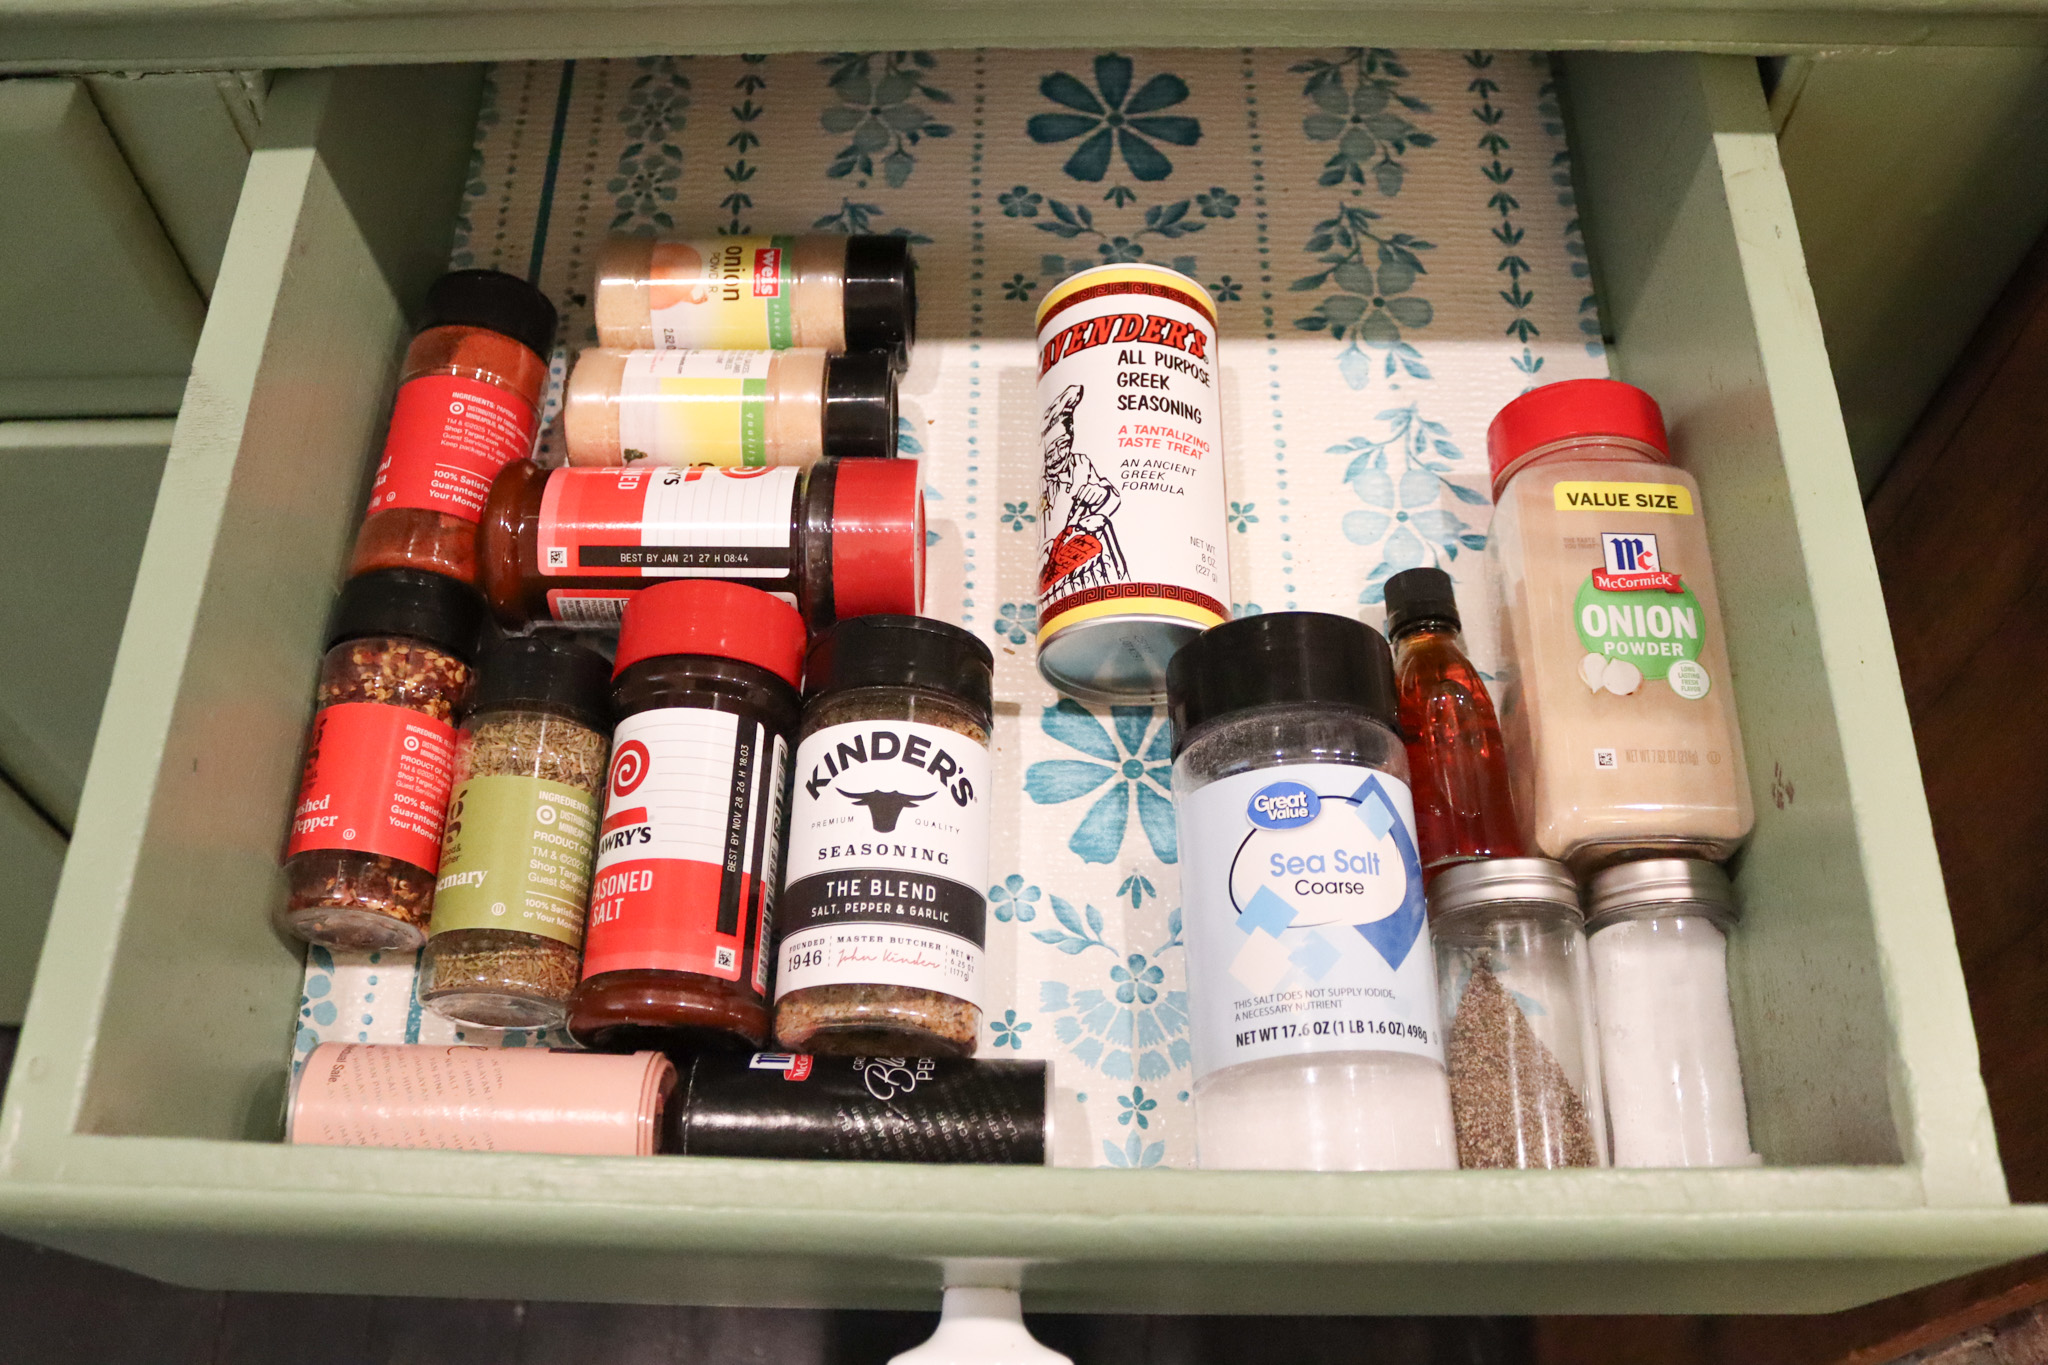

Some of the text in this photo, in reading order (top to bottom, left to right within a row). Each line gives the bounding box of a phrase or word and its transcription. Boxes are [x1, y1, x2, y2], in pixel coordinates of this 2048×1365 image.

[708, 252, 720, 294] POWDR
[722, 246, 745, 302] onion
[760, 250, 777, 295] weis
[1037, 314, 1207, 379] AVENDER'S
[1117, 349, 1210, 387] ALL PURPOSE
[1117, 372, 1171, 391] GREEK
[1117, 395, 1202, 424] SEASONING
[444, 425, 462, 434] Shop
[1118, 425, 1210, 453] A TANTALIZING
[1117, 438, 1203, 460] TASTE TREAT
[1120, 459, 1198, 477] AN ANCIENT
[1120, 470, 1166, 481] GREEK
[431, 480, 484, 501] Guaranteed
[434, 470, 490, 493] 100% Satisfa
[1122, 482, 1185, 496] FORMULA
[429, 489, 481, 512] Your Money
[1566, 492, 1679, 509] VALUE SIZE
[1190, 536, 1203, 549] NET
[619, 553, 749, 563] BEST BY JAN 21 27 H 08:44
[1202, 553, 1206, 562] 8
[1596, 575, 1672, 589] McCormick
[1581, 604, 1698, 639] ONION
[1604, 641, 1685, 657] POWDER
[401, 754, 434, 770] PRODUCT
[740, 744, 749, 768] 18:03
[397, 771, 414, 782] Shop
[805, 731, 974, 808] KINDER'S
[737, 781, 745, 794] 26
[296, 793, 331, 817] shed
[394, 793, 445, 821] 100% Satisfac
[735, 795, 744, 809] 28
[1254, 791, 1308, 812] Great
[391, 804, 438, 830] Guaranteed
[732, 811, 743, 831] NOV
[1267, 806, 1308, 821] Value
[389, 816, 436, 843] Your Money
[811, 815, 961, 834] PREMIUM QUALITY
[533, 830, 579, 851] PRODUCT
[599, 827, 651, 855] AWRY'S
[731, 830, 740, 846] BY
[532, 846, 548, 858] TM
[550, 851, 557, 860] &
[727, 847, 738, 873] BEST
[818, 844, 950, 865] SEASONING
[1270, 849, 1380, 877] Sea Salt
[529, 859, 556, 874] Shop
[528, 872, 557, 887] Guest
[1295, 879, 1365, 896] Coarse
[826, 879, 937, 902] THE BLEND
[525, 898, 549, 910] 100%
[592, 898, 624, 927] SALT
[811, 902, 950, 923] SALT, PEPPER & GARLIC
[536, 911, 555, 923] Your
[556, 917, 578, 934] Money
[788, 938, 826, 953] FOUNDED
[836, 935, 942, 950] MASTER BUTCHER
[951, 948, 963, 958] NET
[787, 950, 822, 973] 1946
[836, 947, 940, 968] John Kinder
[1234, 987, 1396, 1010] THIS SALT DOES NOT SUPPLY IODIDE,
[1235, 1000, 1343, 1022] A NECESSARY NUTRIENT
[1236, 1020, 1428, 1048] NET WT 17.6 OZ (1 LB 1.6 OZ) 498g
[326, 1064, 345, 1086] Sale.
[864, 1057, 916, 1099] Bla
